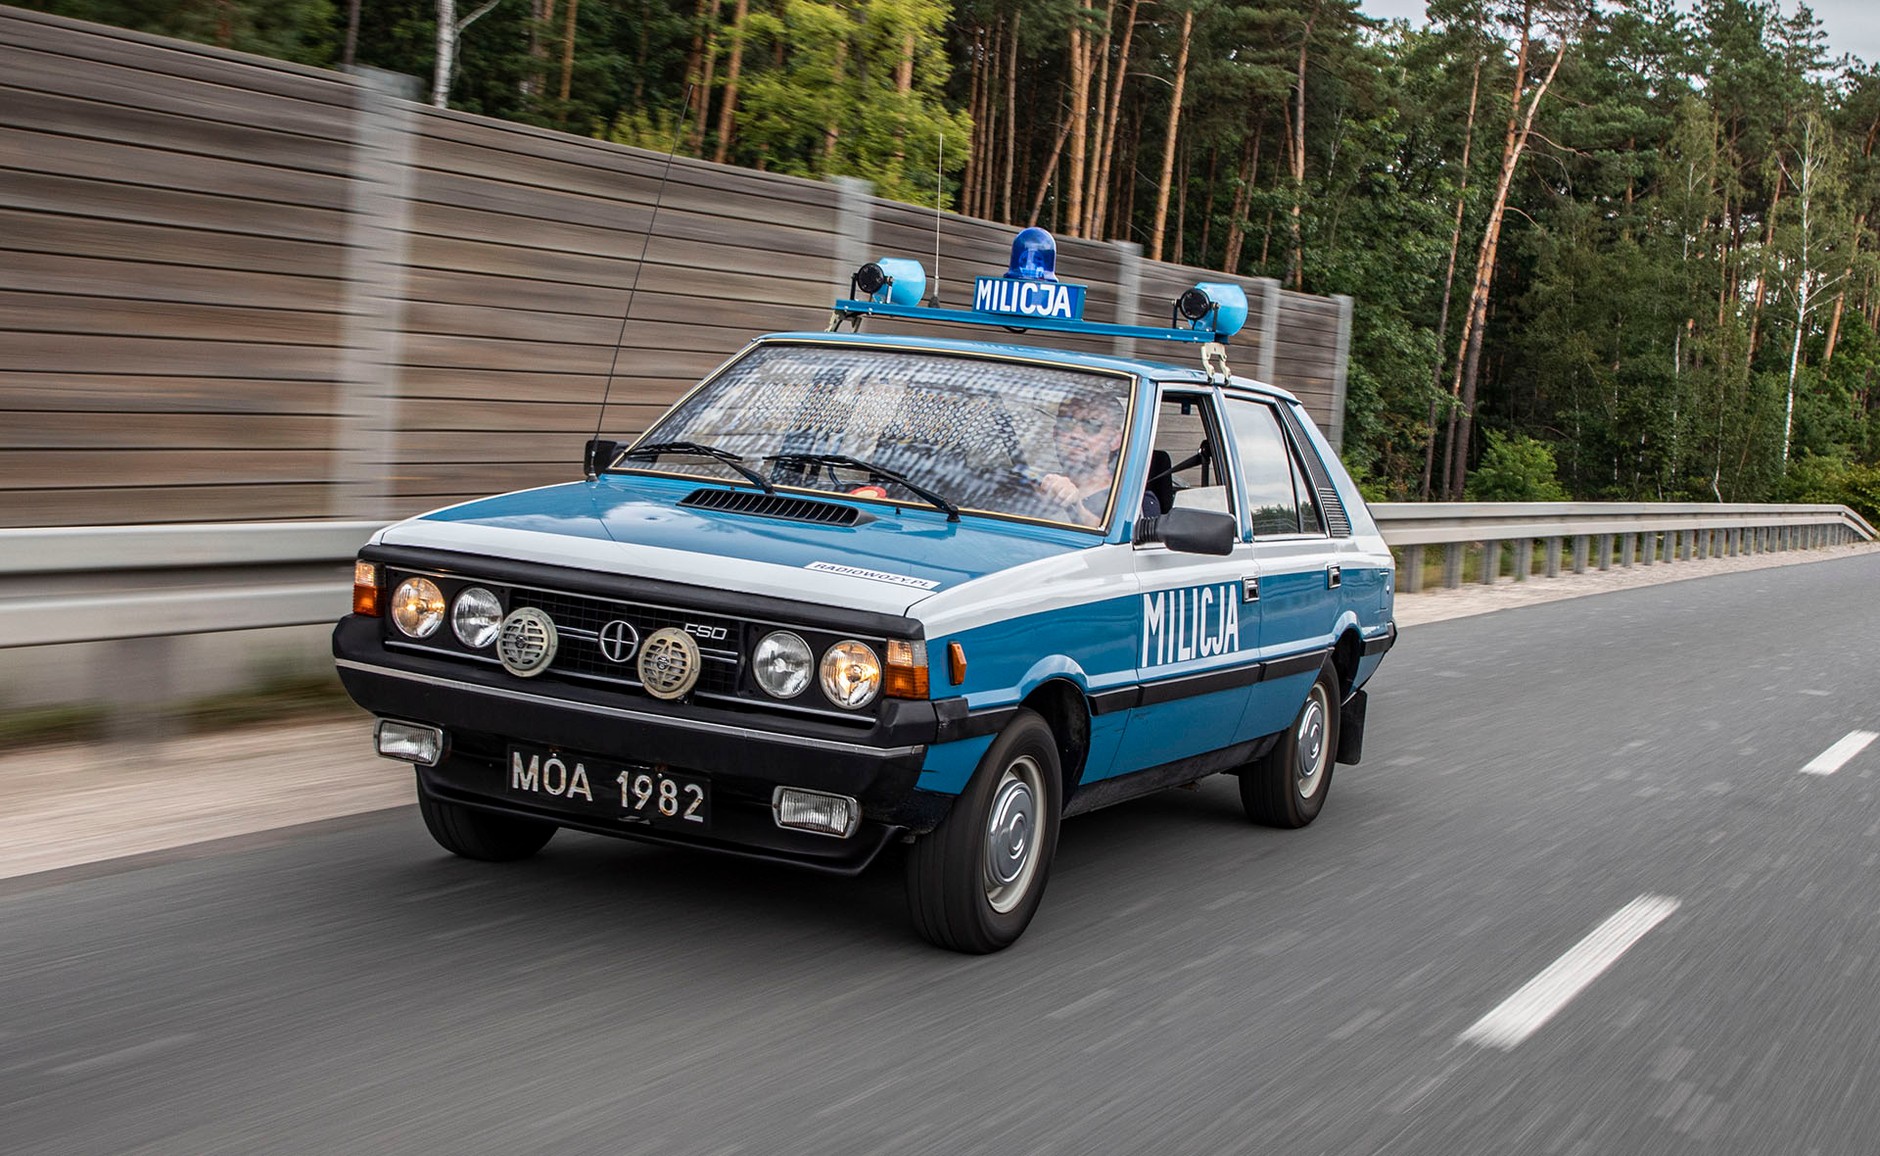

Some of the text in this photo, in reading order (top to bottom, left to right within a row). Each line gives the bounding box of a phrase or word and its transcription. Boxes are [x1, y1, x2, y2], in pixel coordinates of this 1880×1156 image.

[976, 280, 1071, 318] MILICJA
[813, 563, 929, 588] RADIOWOZY.PL
[684, 623, 727, 640] FSO
[1142, 584, 1239, 668] MILICJA
[512, 752, 704, 823] MOA 1982
